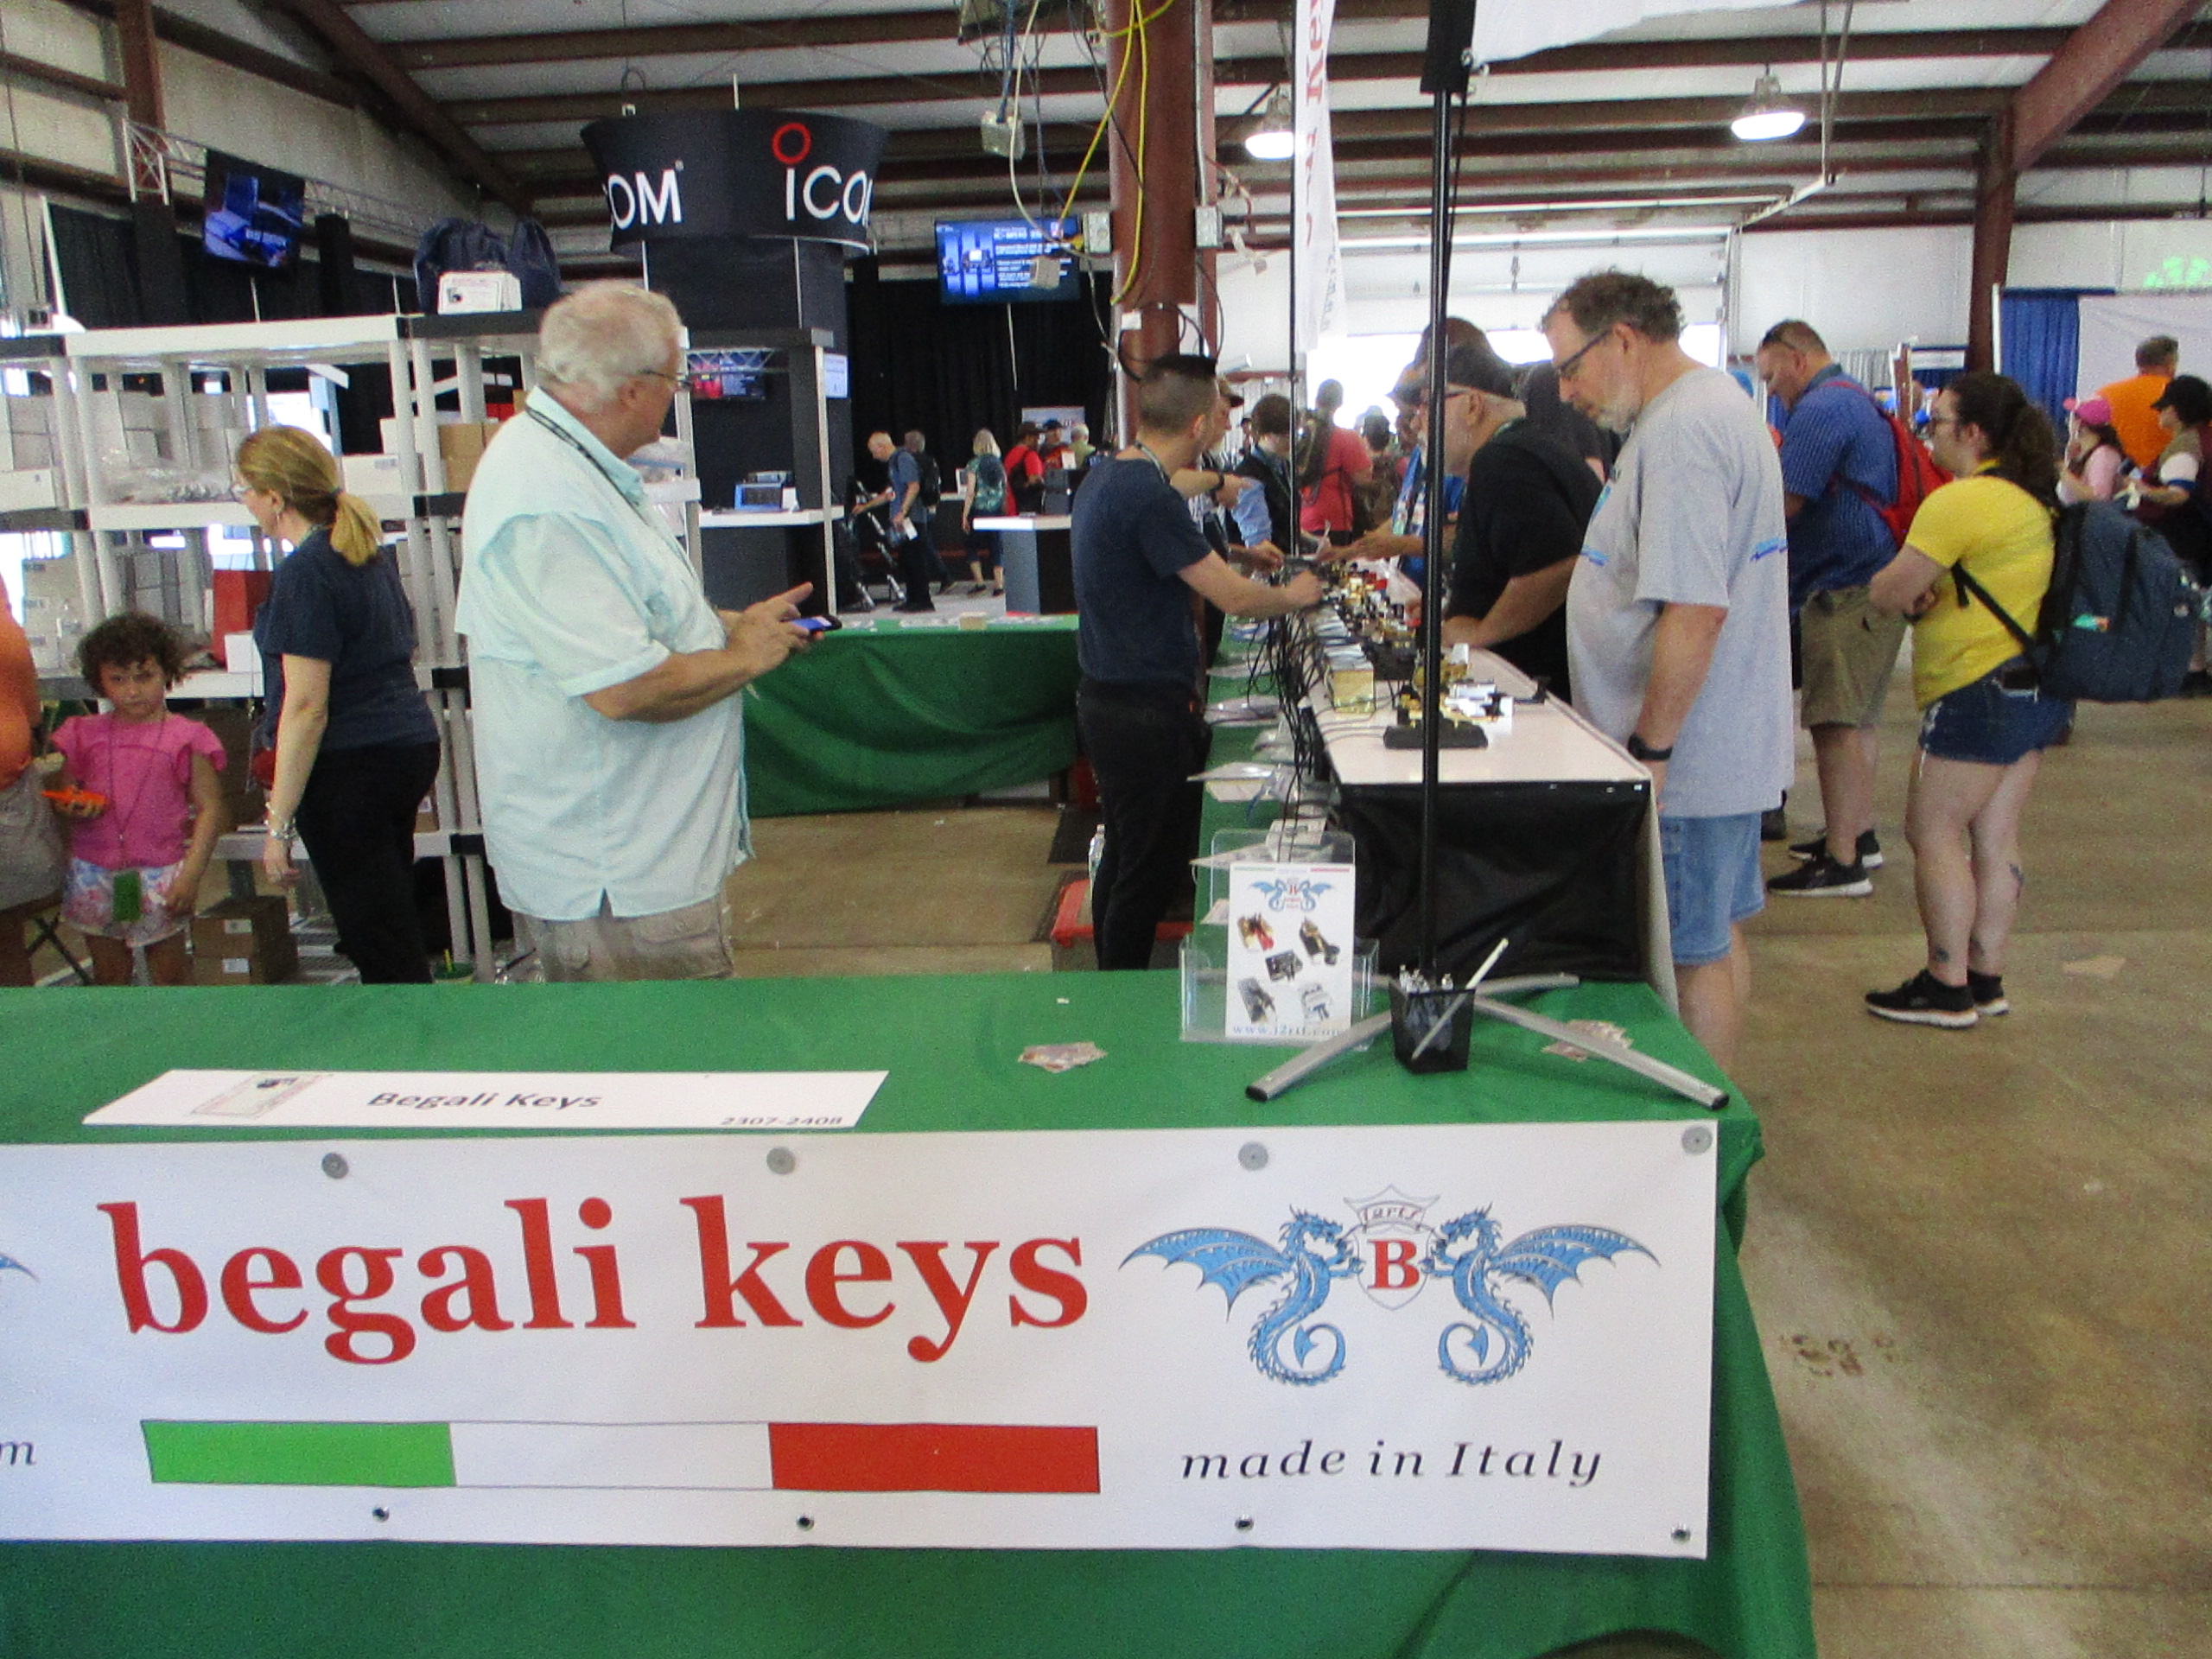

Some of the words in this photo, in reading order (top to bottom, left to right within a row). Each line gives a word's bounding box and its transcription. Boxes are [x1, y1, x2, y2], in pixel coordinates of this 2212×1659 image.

[603, 168, 683, 230] OM
[367, 1092, 499, 1109] Begali
[505, 1093, 602, 1109] Keys
[721, 1116, 842, 1125] 2307-2408
[97, 1197, 636, 1365] begali
[679, 1194, 1089, 1363] keys
[1367, 1238, 1420, 1289] B
[1181, 1440, 1346, 1479] made
[1368, 1440, 1425, 1478] in
[1445, 1440, 1602, 1488] Italy
